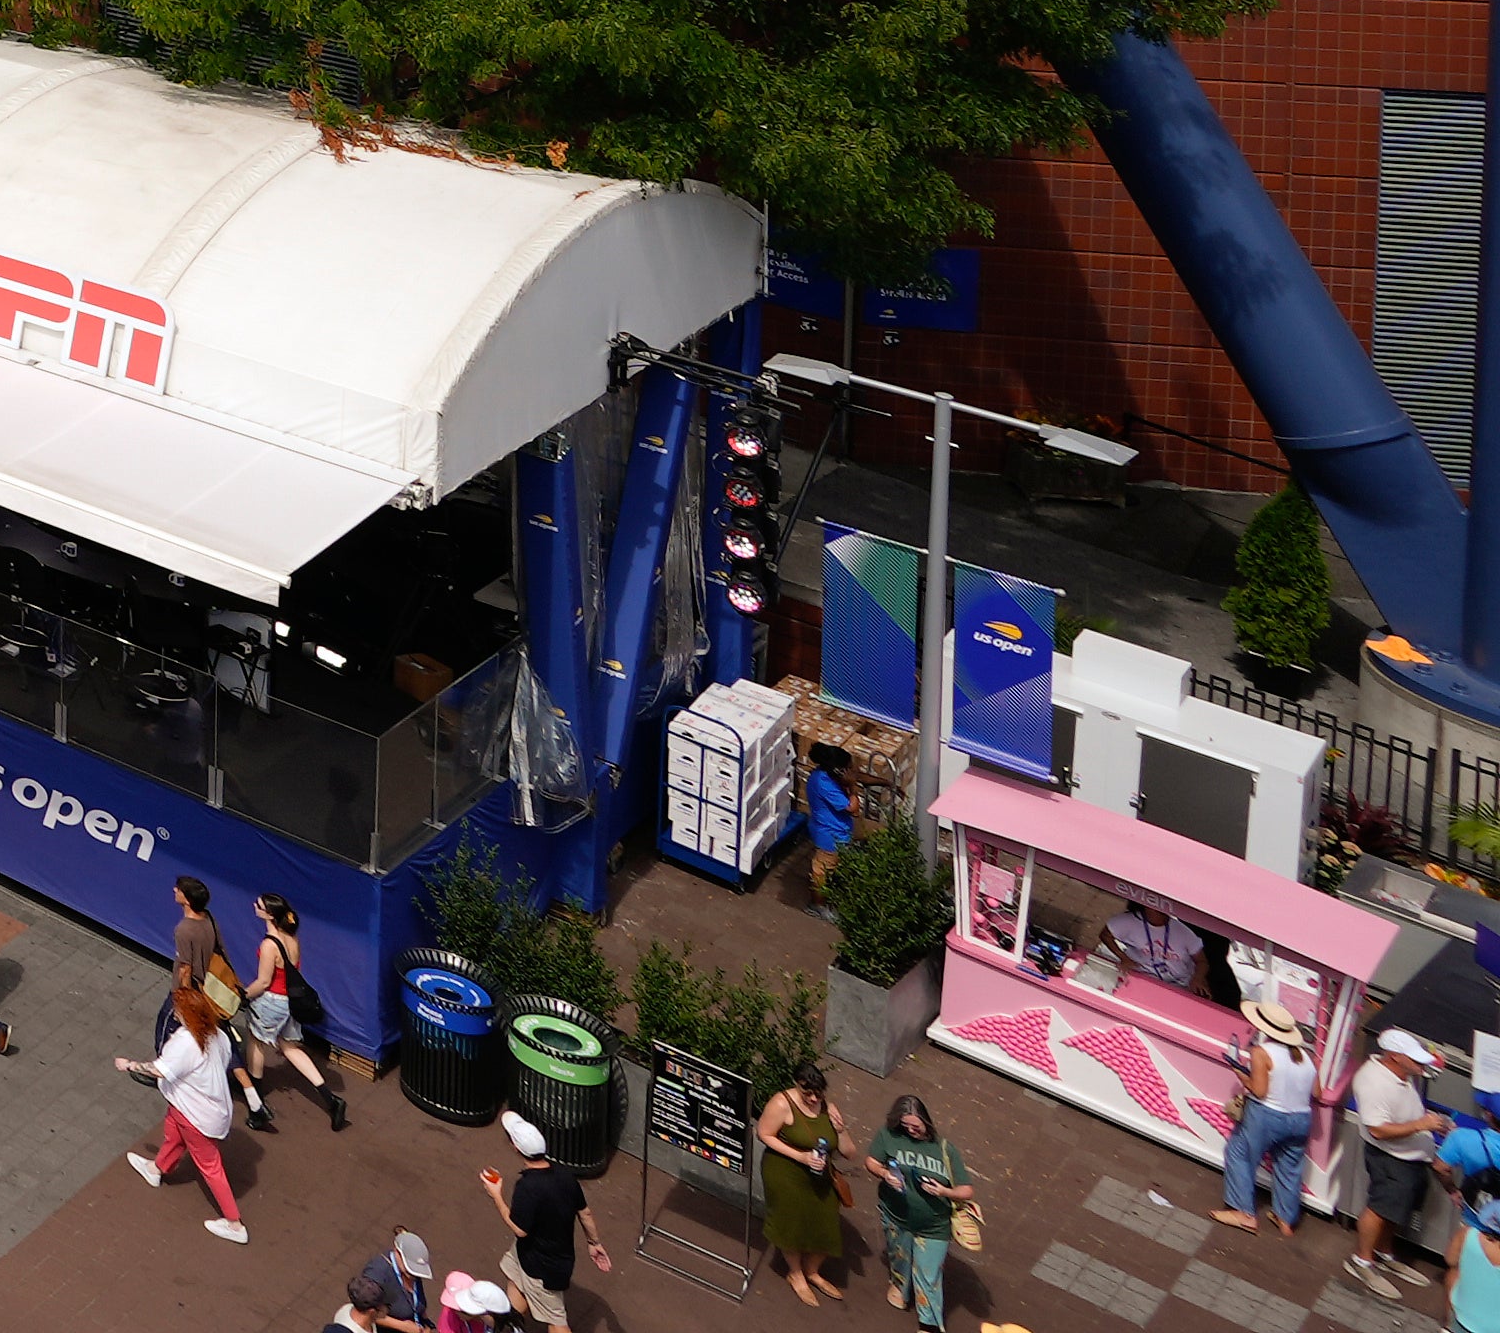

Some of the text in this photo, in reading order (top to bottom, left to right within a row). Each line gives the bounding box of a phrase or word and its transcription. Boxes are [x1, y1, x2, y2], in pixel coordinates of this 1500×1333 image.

[973, 631, 1033, 657] us open
[11, 777, 156, 862] open
[1115, 882, 1174, 913] evian
